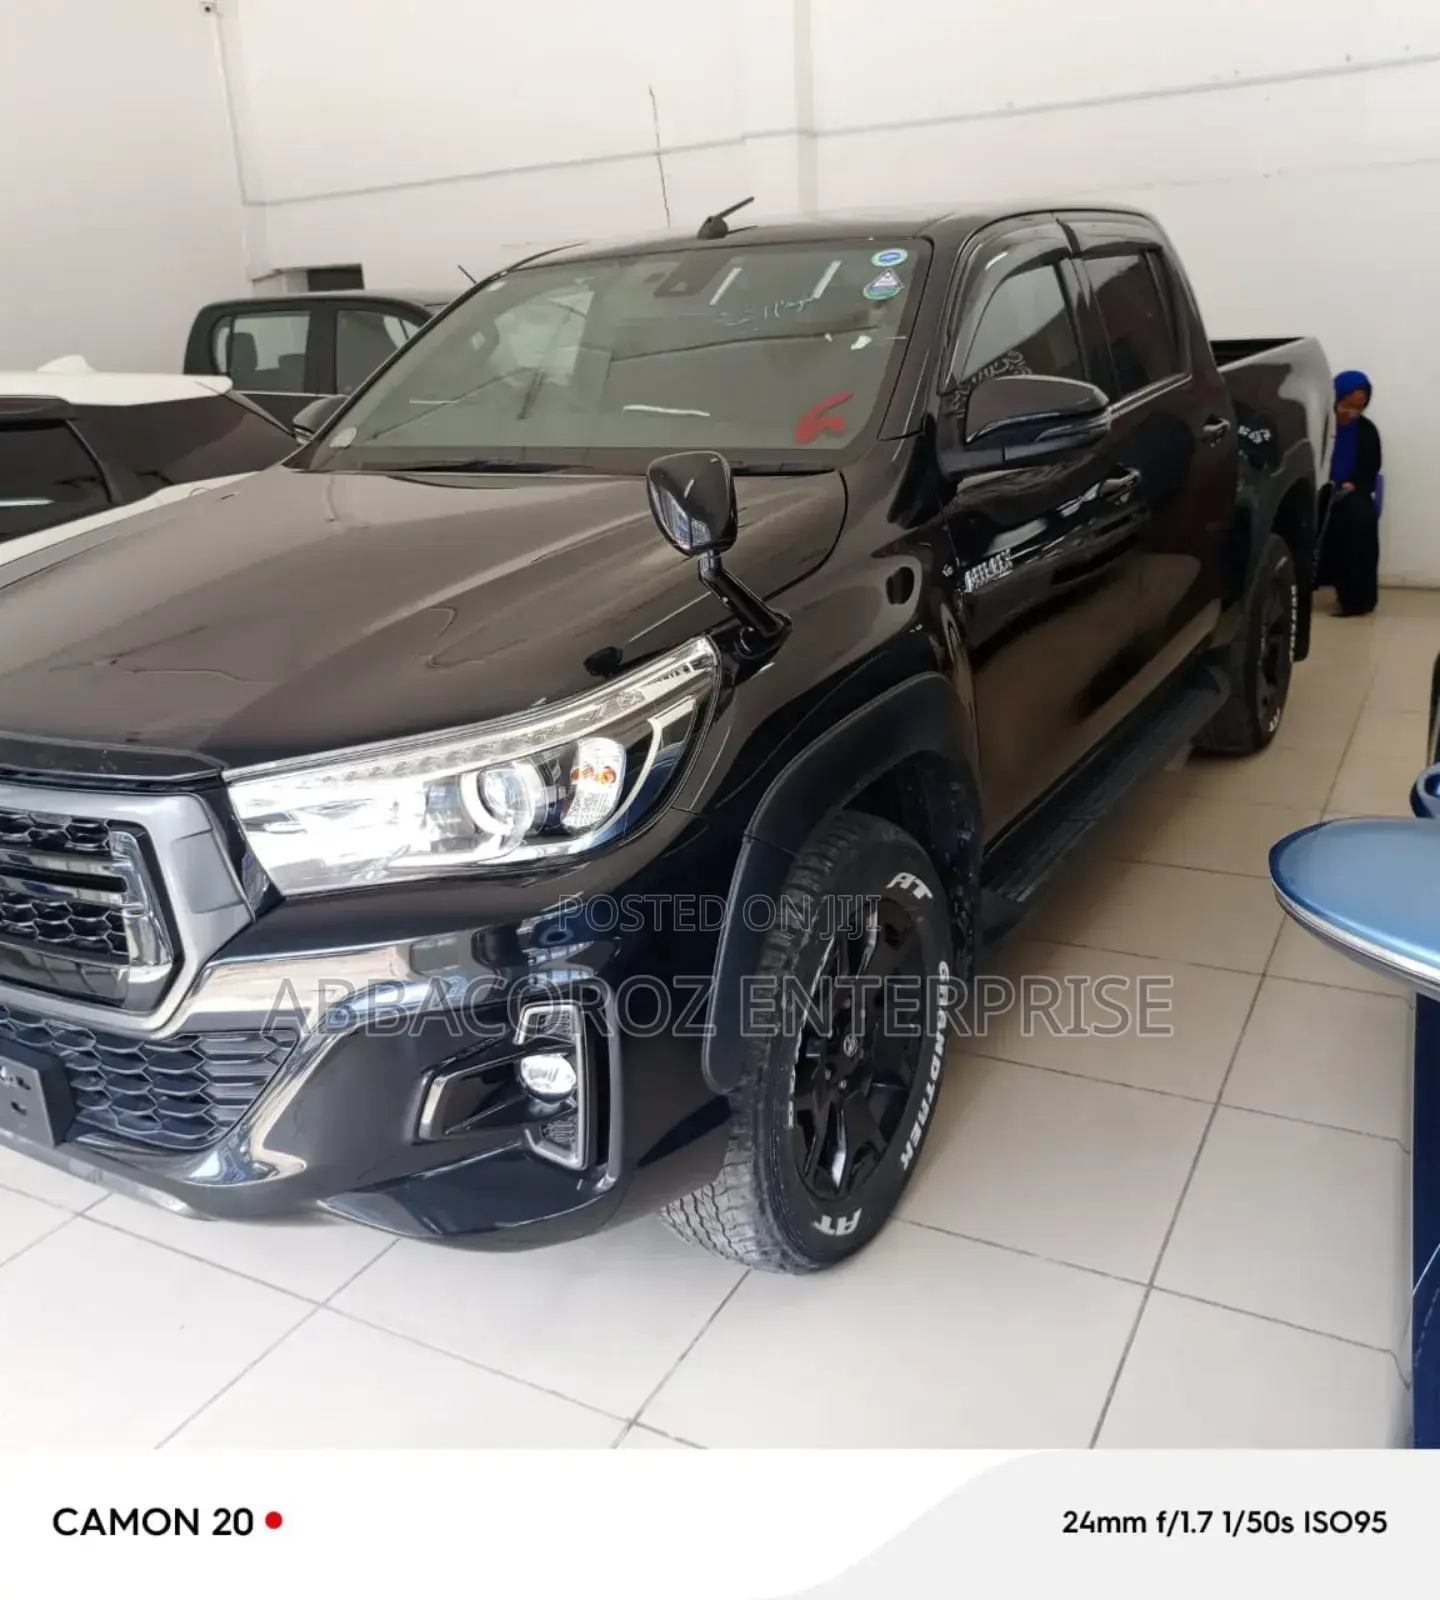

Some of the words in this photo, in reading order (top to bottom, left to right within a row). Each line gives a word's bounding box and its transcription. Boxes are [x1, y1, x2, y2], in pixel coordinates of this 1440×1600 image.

[885, 872, 933, 899] AT
[900, 961, 950, 1170] GRANDTREK
[813, 1208, 862, 1236] AT
